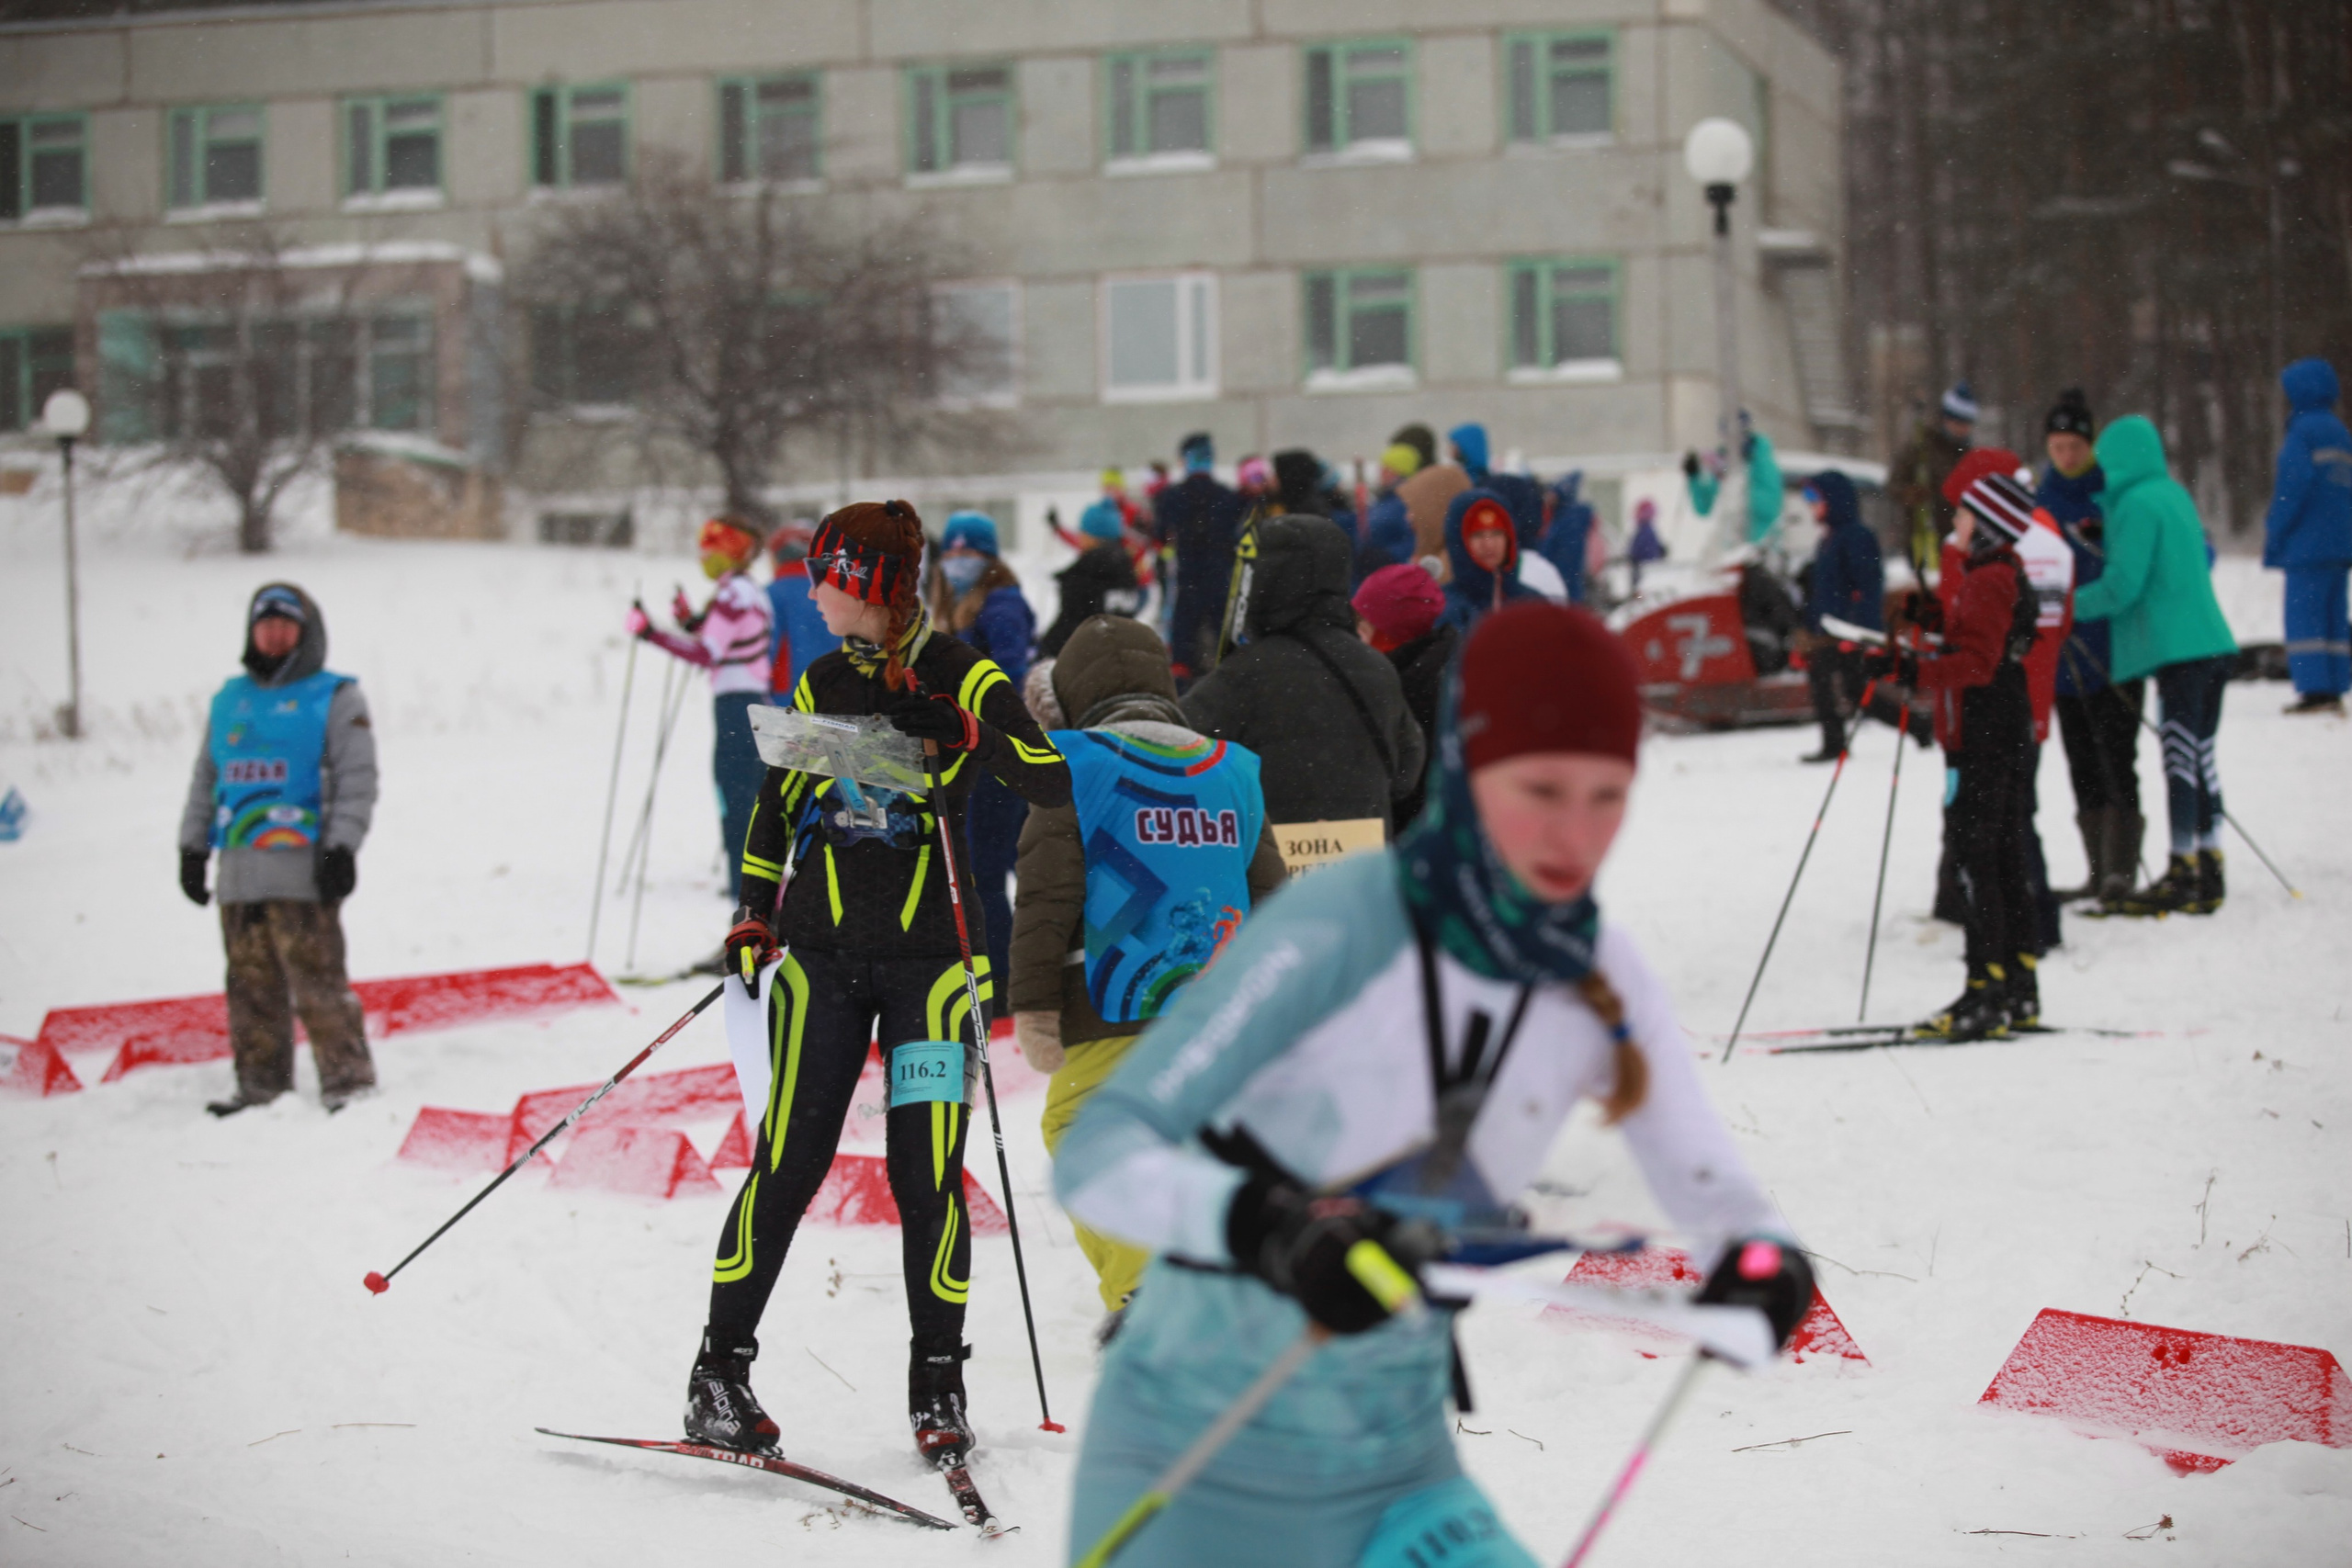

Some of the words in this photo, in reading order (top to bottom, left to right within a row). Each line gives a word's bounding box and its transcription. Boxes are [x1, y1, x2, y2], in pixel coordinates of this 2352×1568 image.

[1136, 808, 1238, 847] СУДЬЯ
[1285, 837, 1343, 856] ЗОНА
[900, 1060, 947, 1081] 116.2
[708, 1381, 741, 1436] alpina
